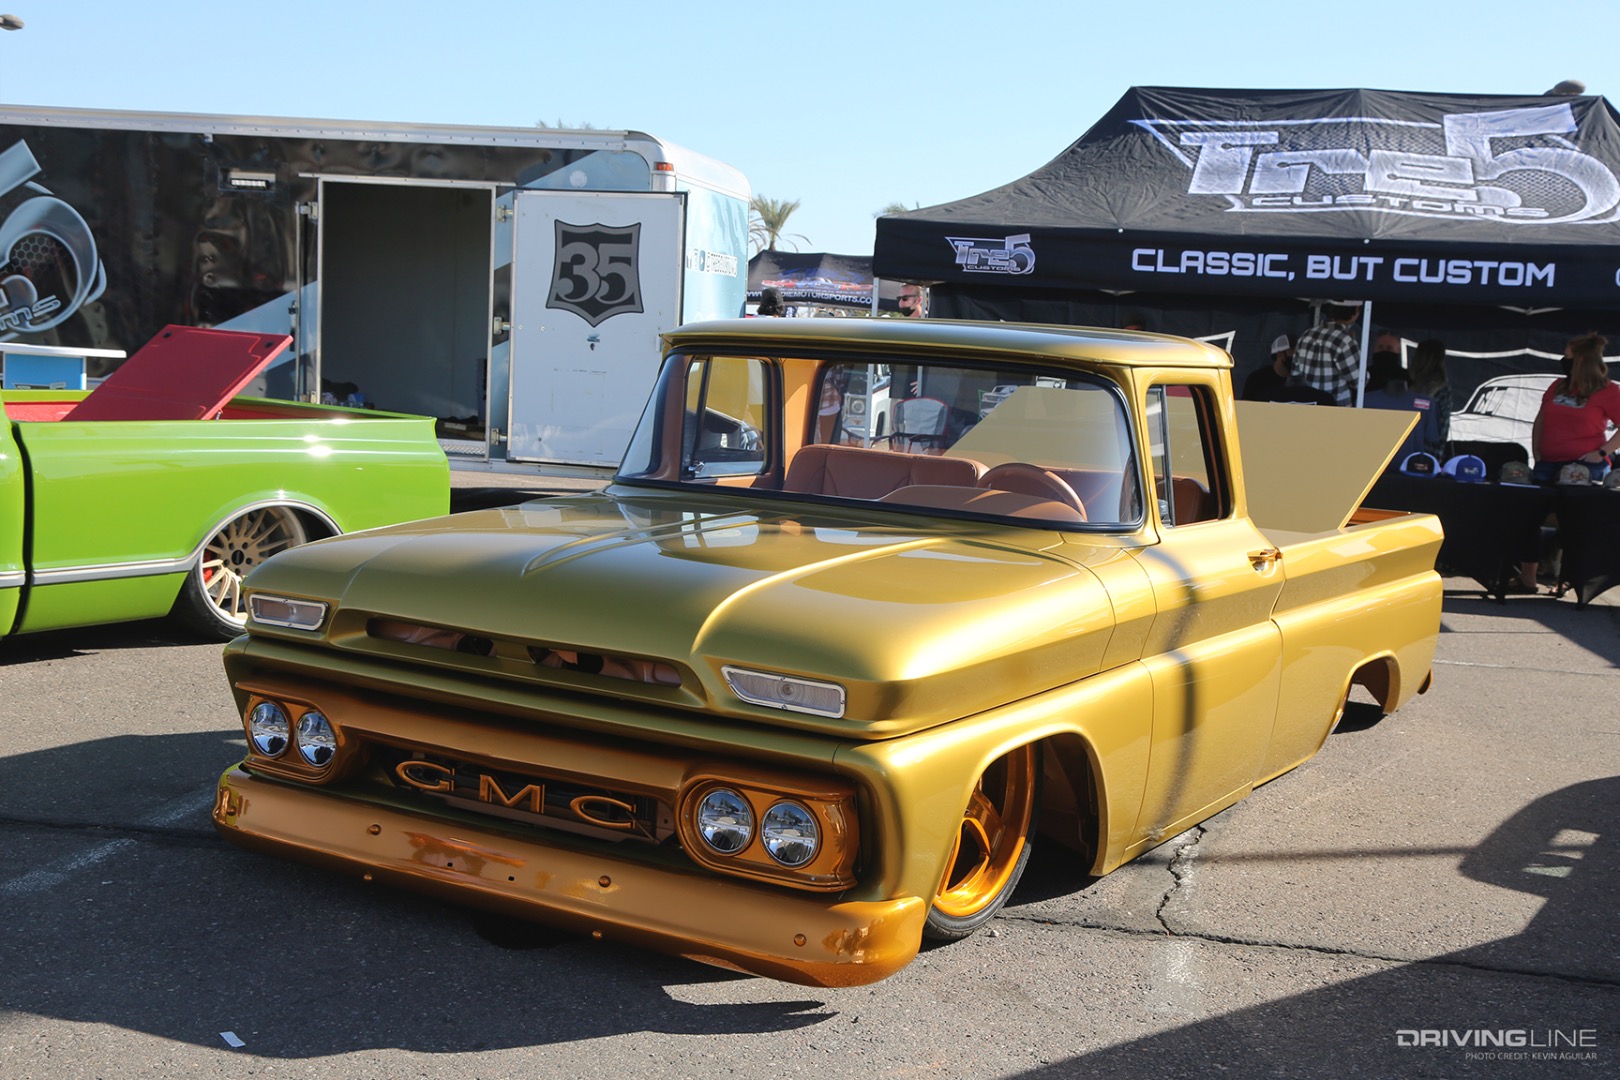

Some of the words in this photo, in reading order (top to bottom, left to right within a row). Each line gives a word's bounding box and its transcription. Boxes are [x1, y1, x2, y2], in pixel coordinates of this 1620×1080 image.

[555, 241, 637, 304] 35
[1132, 248, 1295, 281] CLASSIC,
[1306, 254, 1383, 281] BUT
[1393, 258, 1555, 287] CUSTOM
[396, 760, 637, 829] GMC
